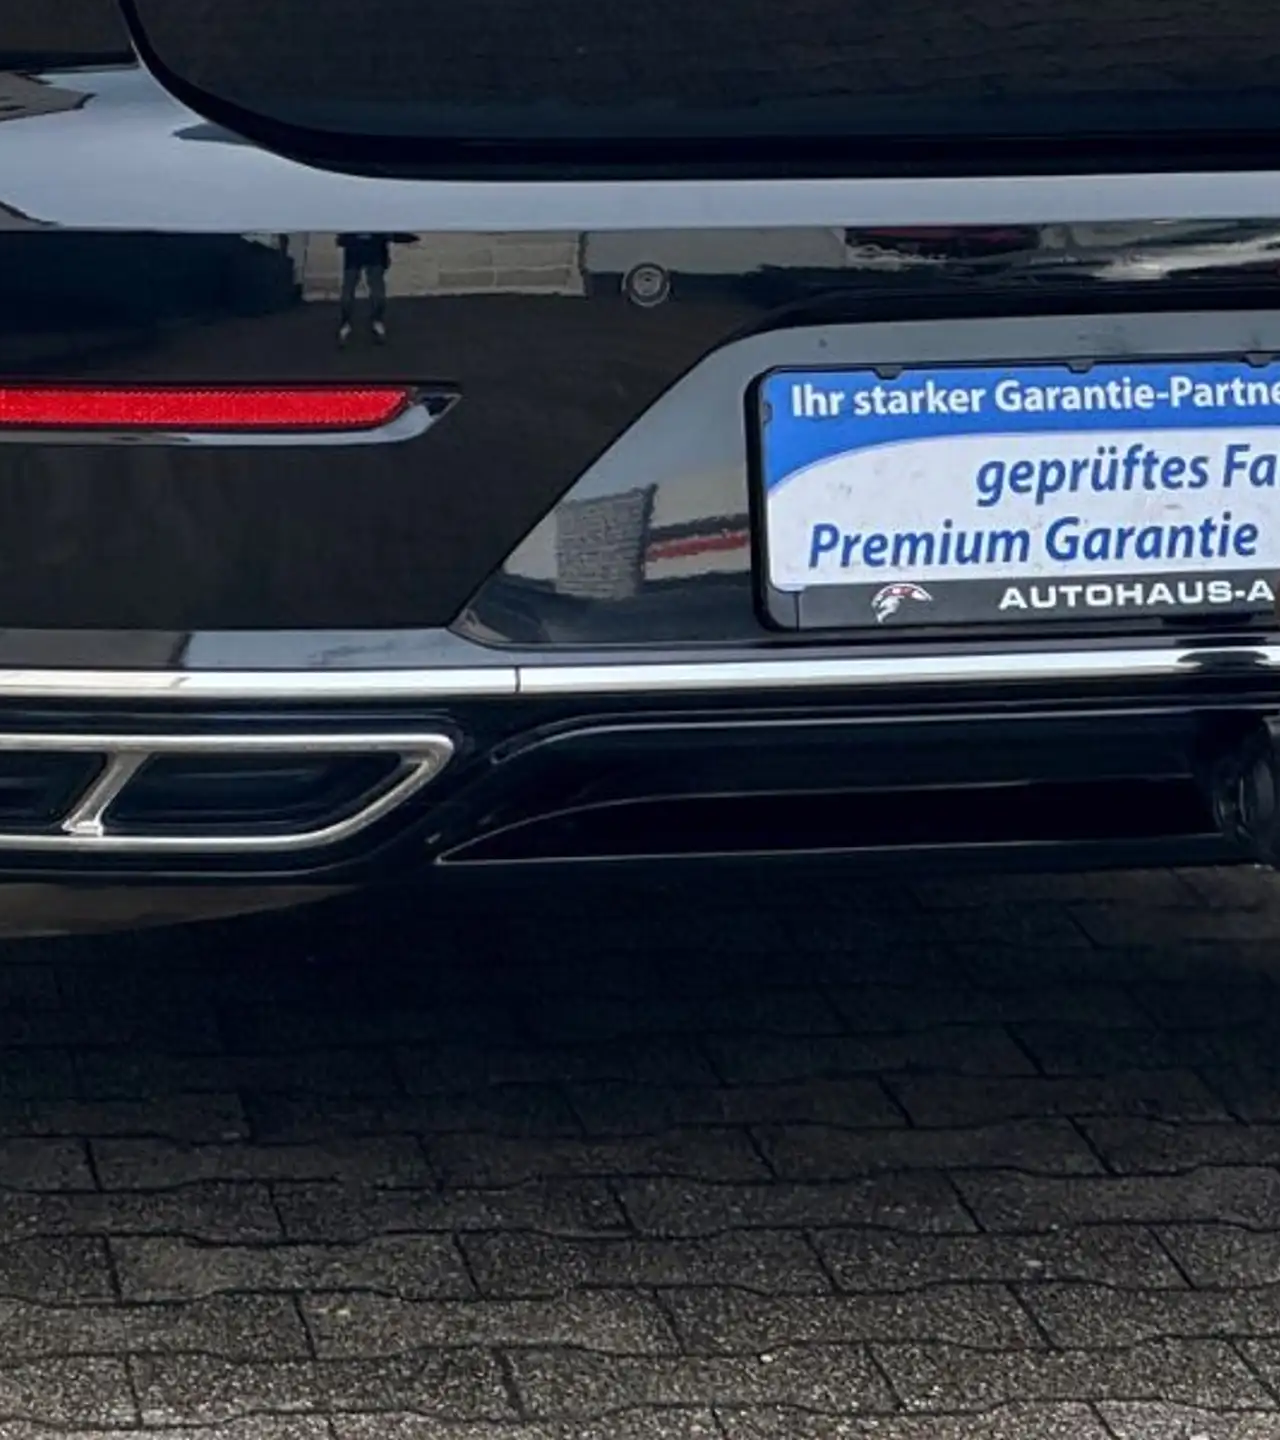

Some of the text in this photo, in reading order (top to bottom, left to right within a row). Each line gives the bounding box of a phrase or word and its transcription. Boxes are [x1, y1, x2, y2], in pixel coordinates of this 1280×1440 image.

[792, 383, 843, 417] Ihr
[853, 379, 986, 416] starker
[976, 443, 1209, 507] geprüftes
[808, 511, 1259, 569] Premium Garantie
